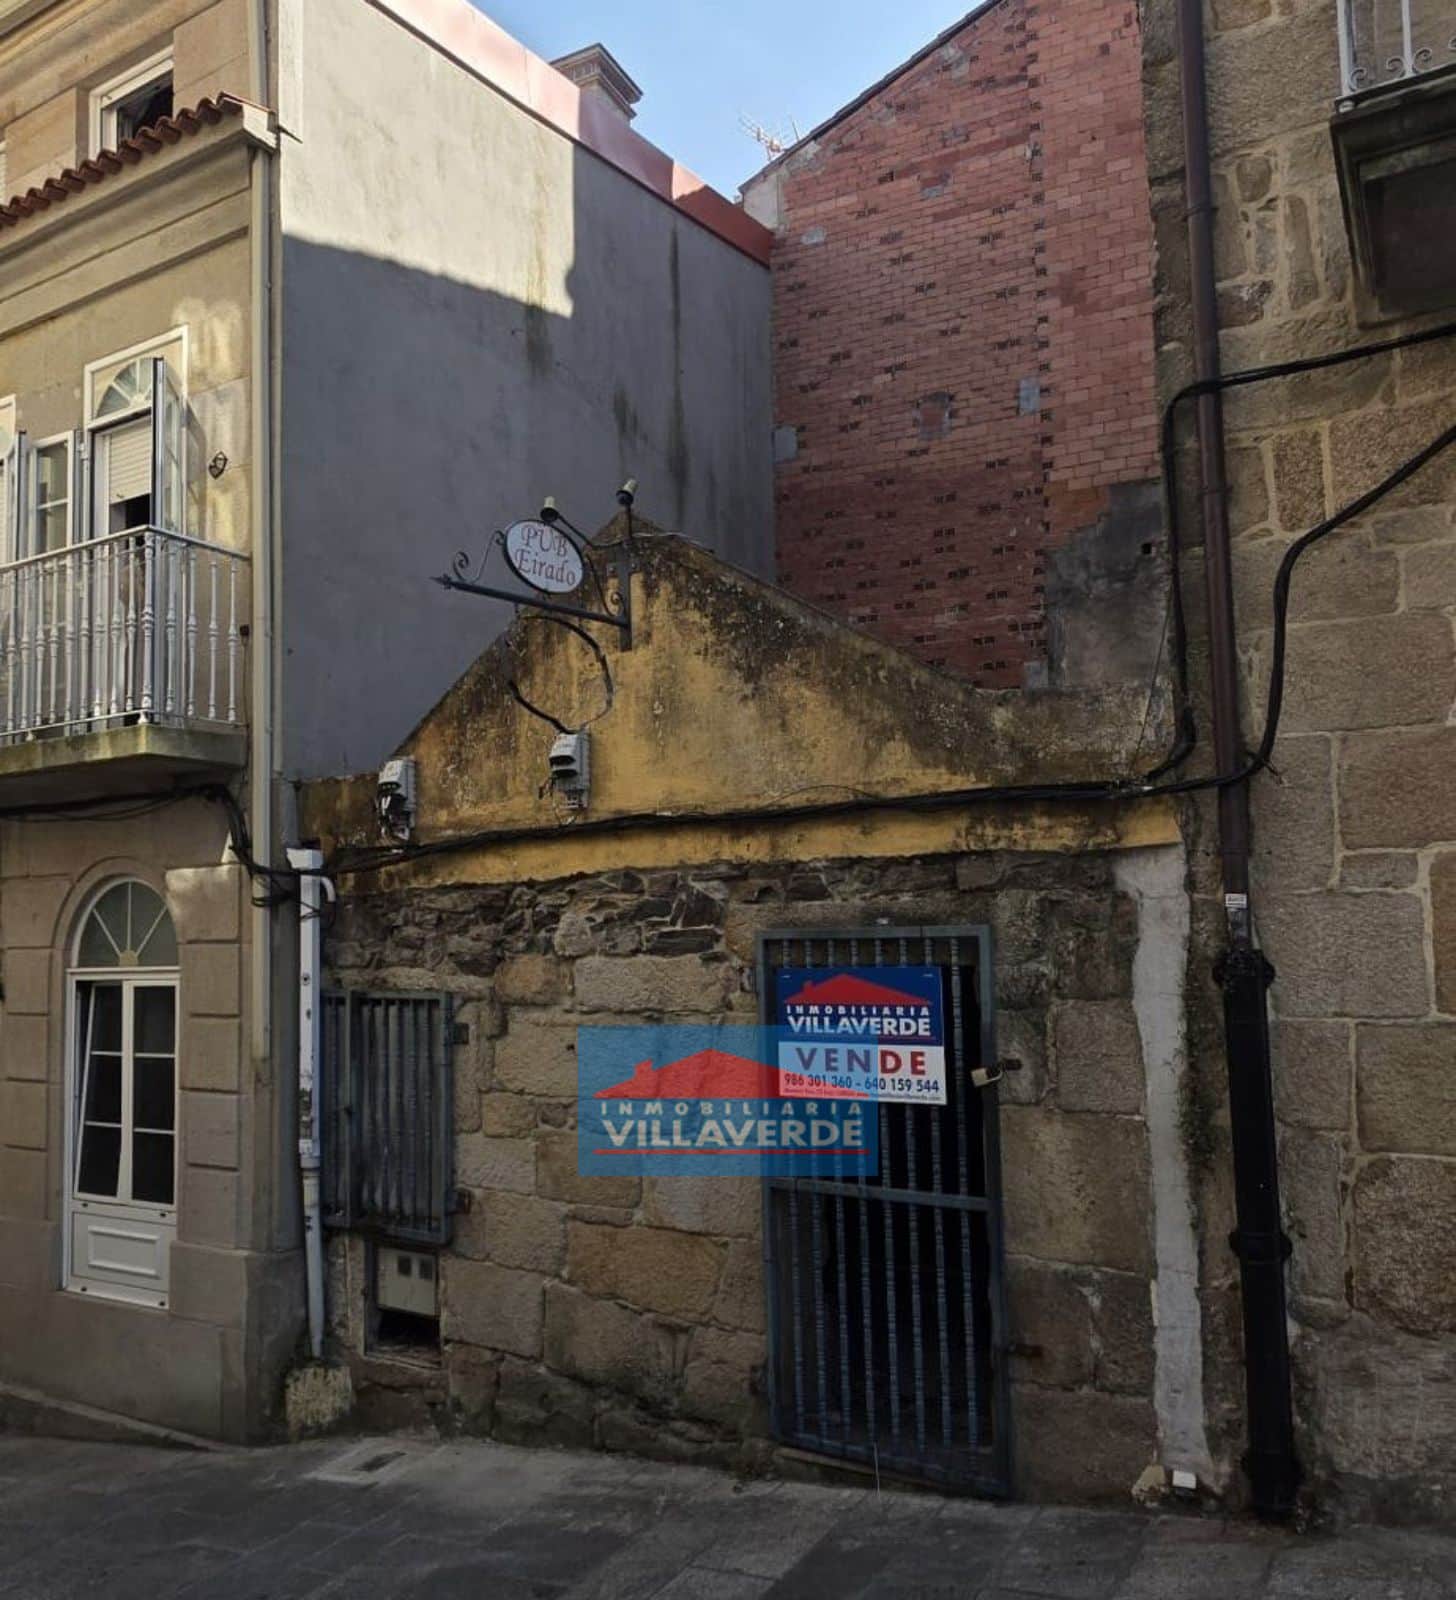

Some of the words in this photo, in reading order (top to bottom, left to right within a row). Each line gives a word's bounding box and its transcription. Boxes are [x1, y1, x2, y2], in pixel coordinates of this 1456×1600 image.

[521, 525, 568, 557] PUB
[514, 549, 576, 586] Eirado
[786, 1005, 930, 1016] INMOBILIARIA
[787, 1016, 931, 1036] VILLAVERDE
[795, 1047, 926, 1076] VENDE
[784, 1073, 804, 1086] 986
[808, 1074, 827, 1087] 301
[831, 1075, 852, 1088] 360
[864, 1077, 886, 1090] 640
[891, 1078, 912, 1091] 159
[917, 1079, 940, 1093] 544
